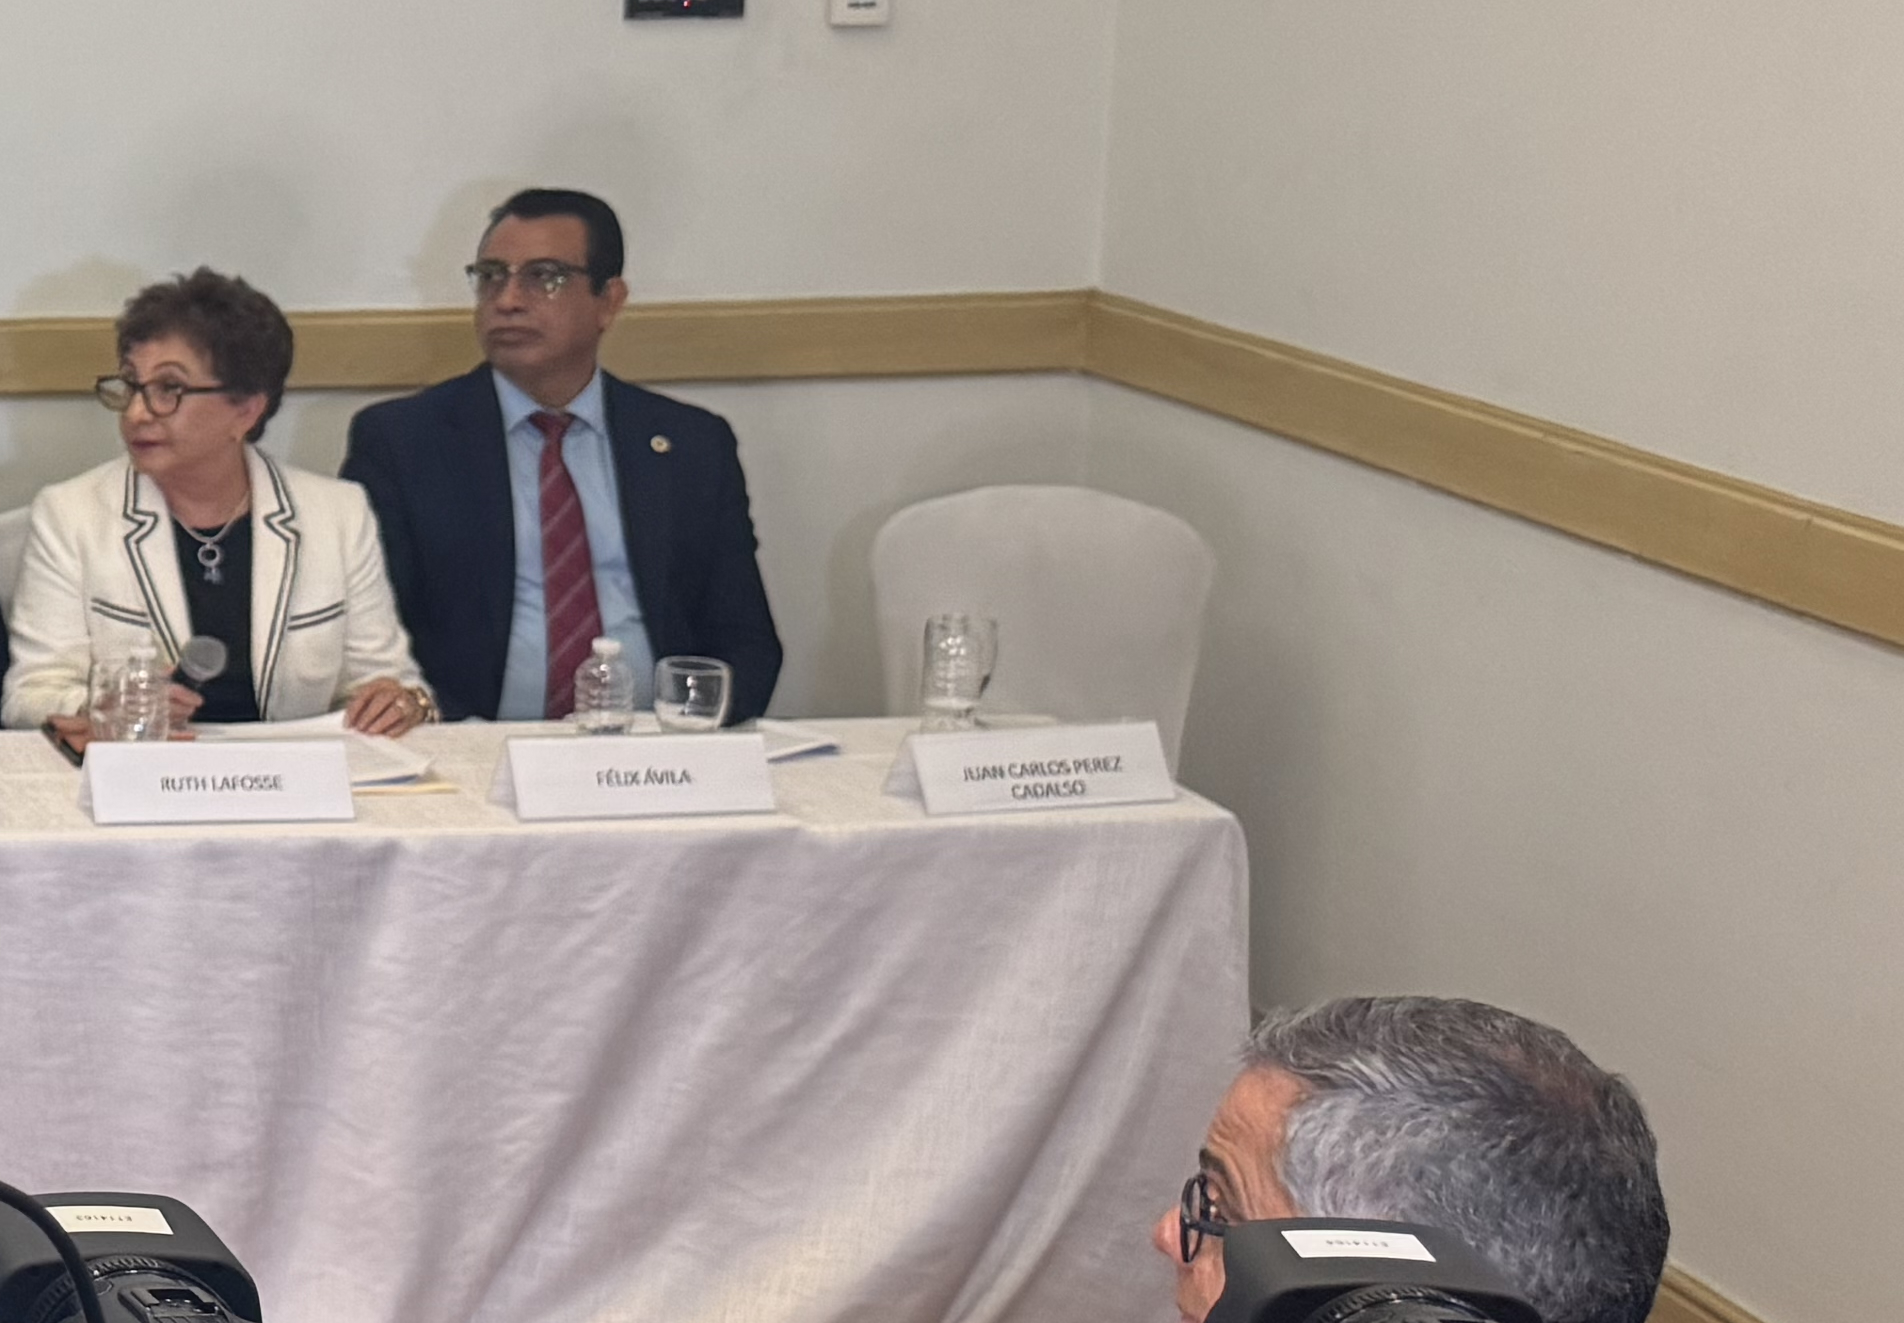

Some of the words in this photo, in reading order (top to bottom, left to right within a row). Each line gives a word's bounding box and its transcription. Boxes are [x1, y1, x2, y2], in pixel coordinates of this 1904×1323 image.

[596, 767, 640, 788] FÉLIX
[642, 766, 692, 785] ÁVILA
[963, 763, 1005, 782] JUAN
[1007, 758, 1071, 778] CARLOS
[1072, 755, 1123, 774] PEREZ
[160, 775, 207, 792] RUTH
[210, 774, 283, 792] LAFOSSE
[1010, 778, 1087, 801] CADALSO
